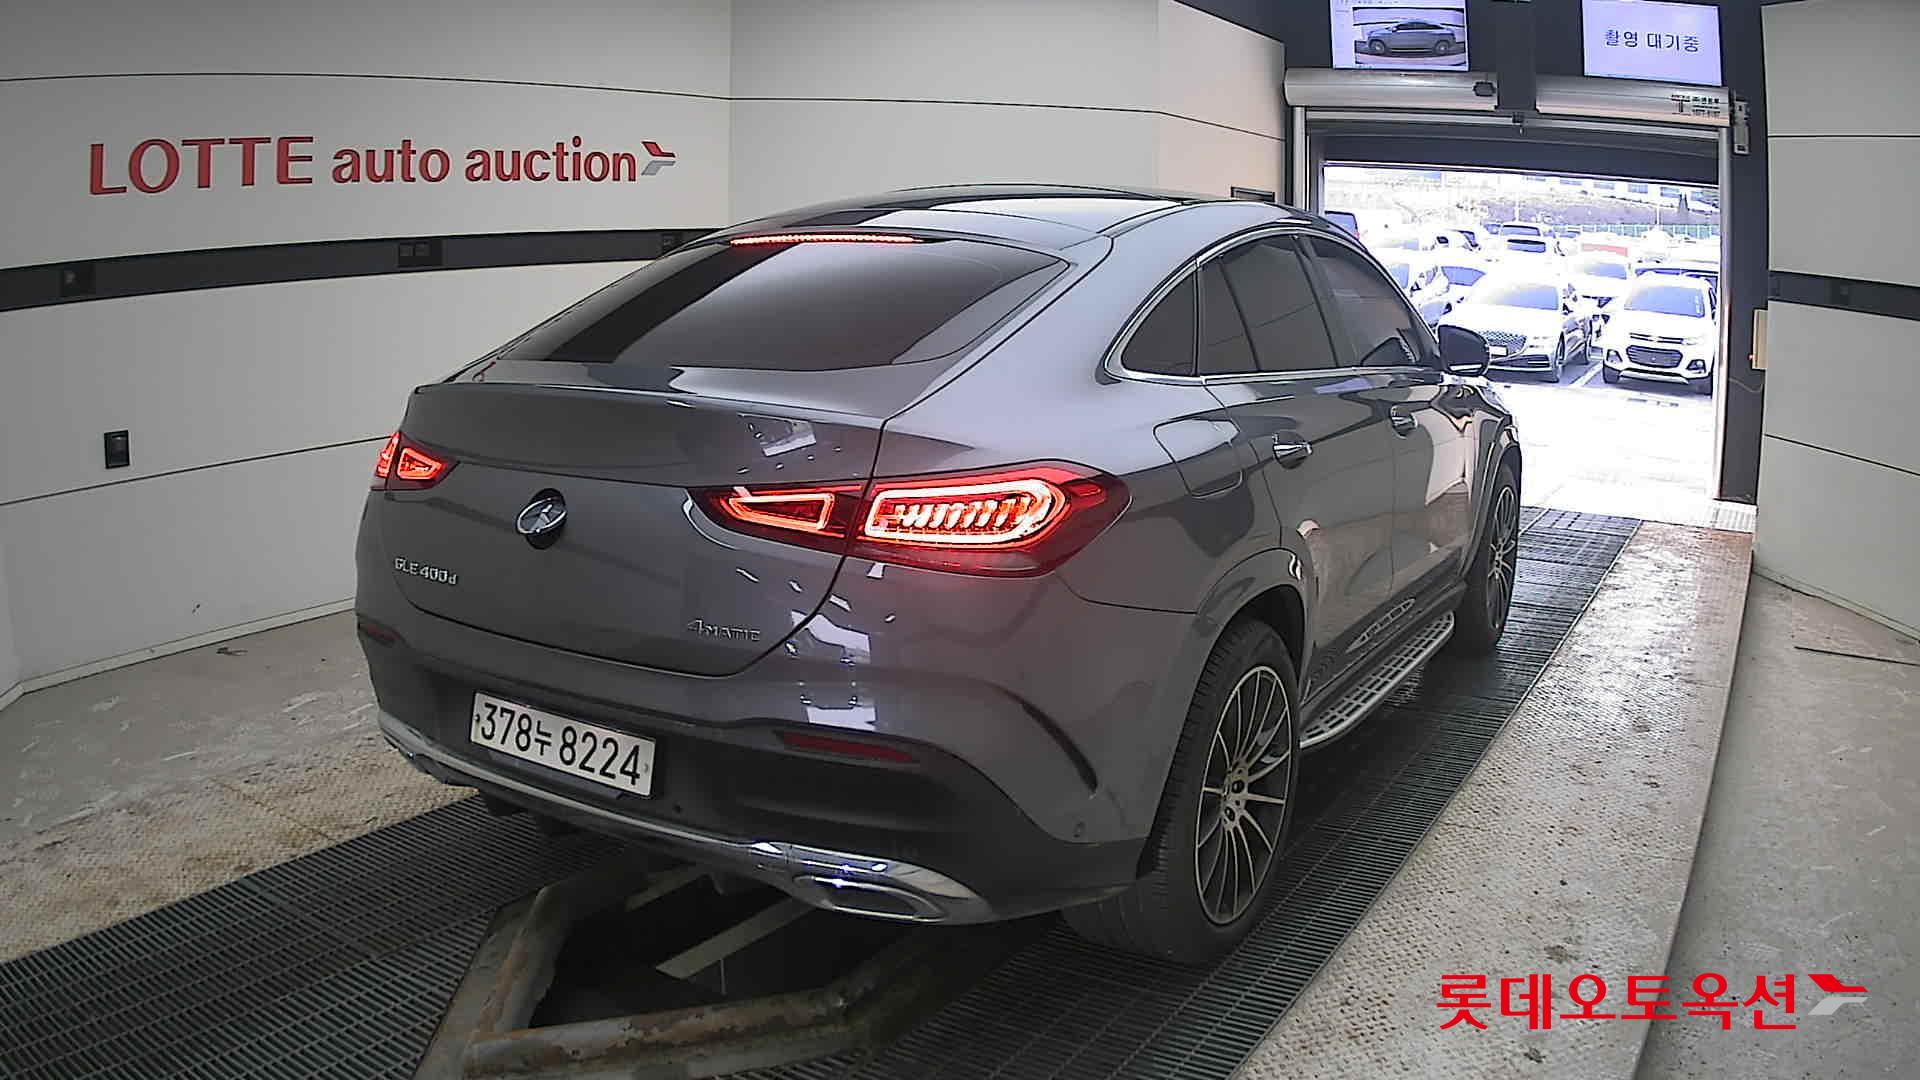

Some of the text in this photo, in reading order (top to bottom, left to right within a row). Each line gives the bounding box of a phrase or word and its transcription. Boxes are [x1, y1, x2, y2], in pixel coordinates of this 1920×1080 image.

[1647, 33, 1699, 52] 대기중
[90, 136, 637, 195] LOTTE auto auction
